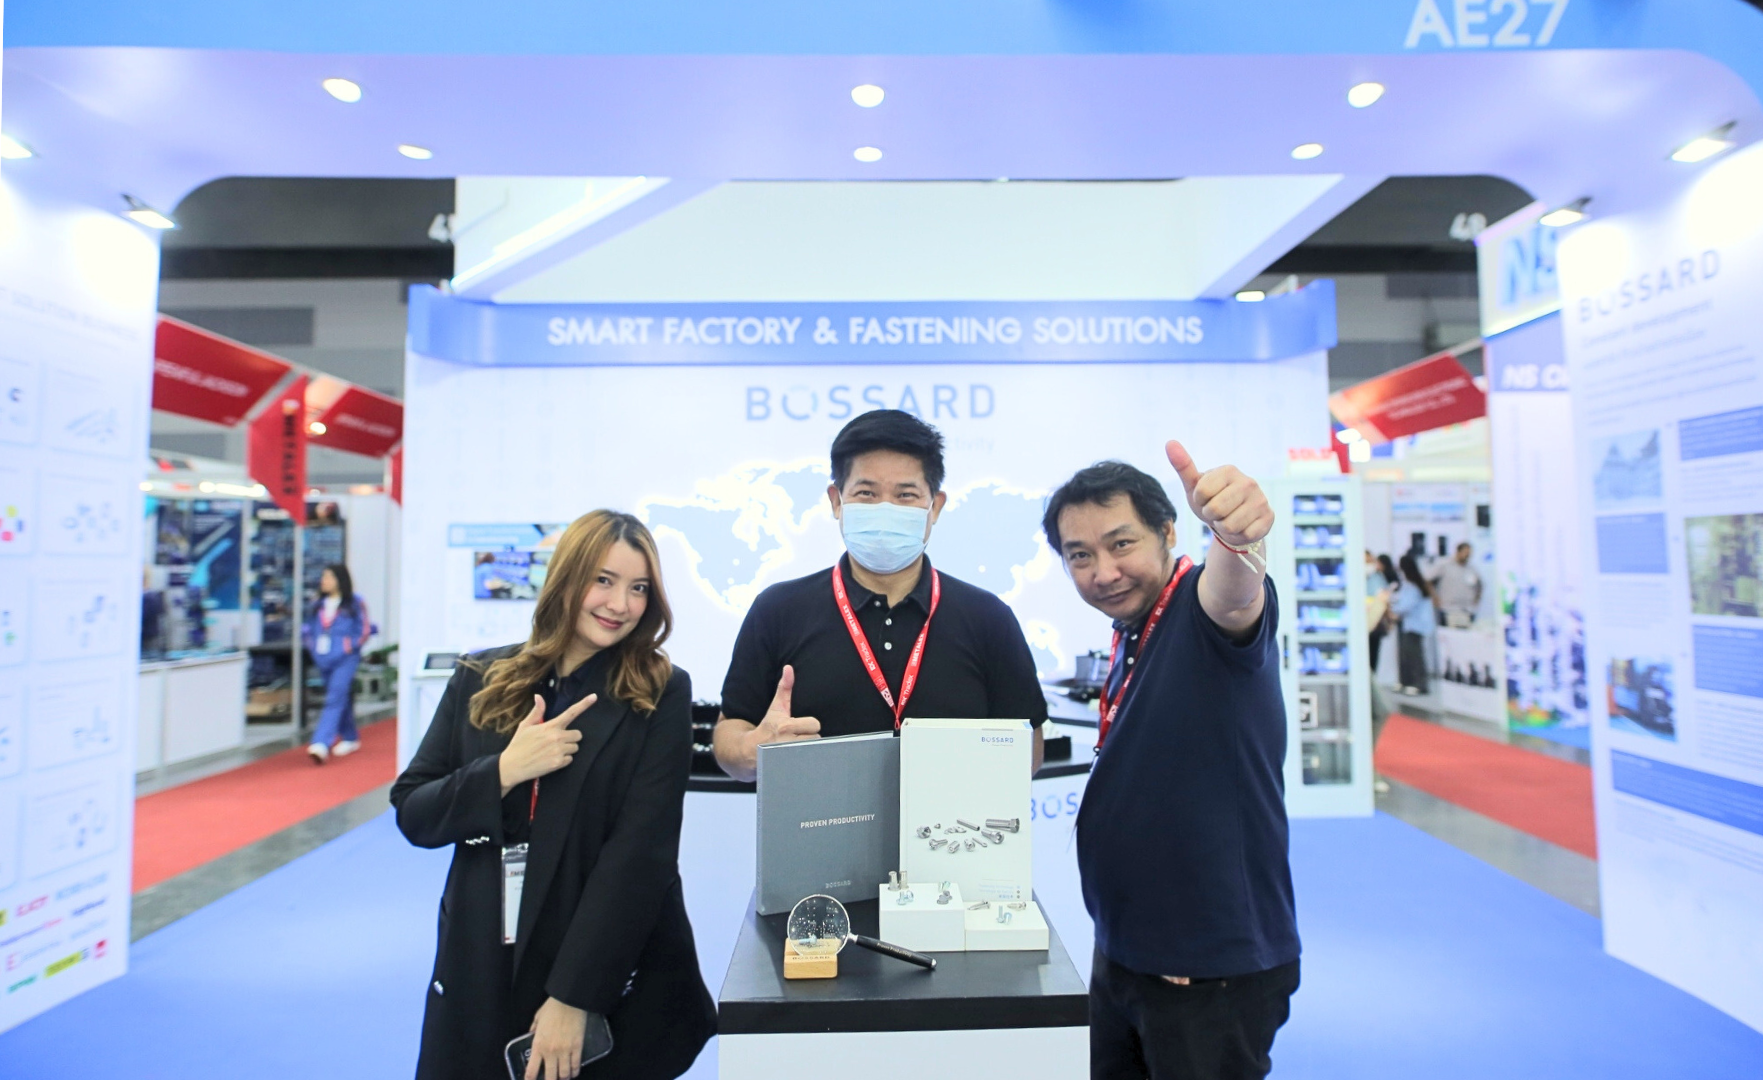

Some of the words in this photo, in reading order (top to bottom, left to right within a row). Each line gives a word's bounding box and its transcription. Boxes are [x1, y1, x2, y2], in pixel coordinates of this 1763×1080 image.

[1404, 0, 1569, 48] AE27
[1580, 249, 1721, 323] BOSSARD
[548, 316, 653, 346] SMART
[663, 316, 802, 345] FACTORY
[812, 316, 840, 345] &
[849, 316, 1022, 344] FASTENING
[1033, 315, 1204, 344] SOLUTIONS
[746, 384, 996, 421] BOSSARD
[981, 736, 1014, 744] BOSSARD
[800, 819, 828, 829] PROVEN
[828, 813, 876, 826] PRODUCTIVITY
